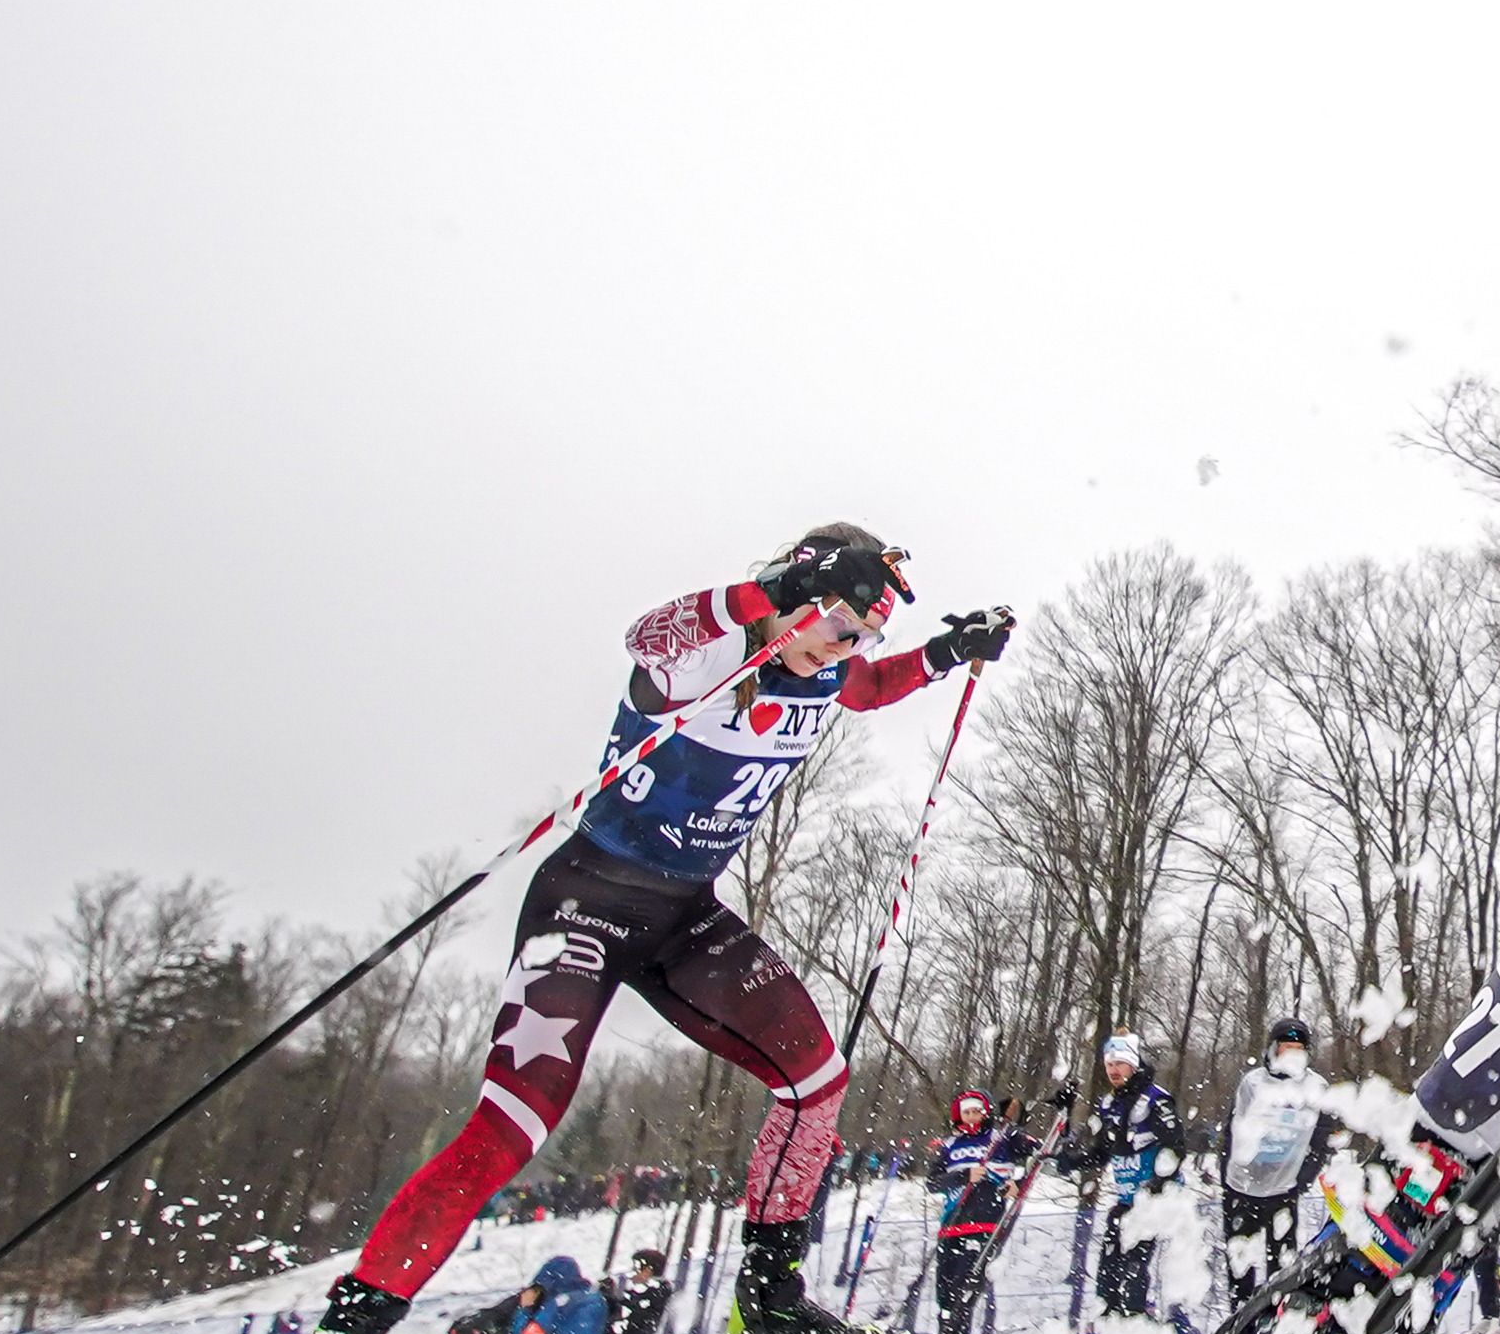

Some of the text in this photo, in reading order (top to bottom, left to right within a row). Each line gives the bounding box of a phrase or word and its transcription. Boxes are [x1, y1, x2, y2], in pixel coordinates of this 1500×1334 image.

[777, 701, 832, 737] NY
[713, 762, 791, 815] 29
[686, 812, 728, 833] Lake
